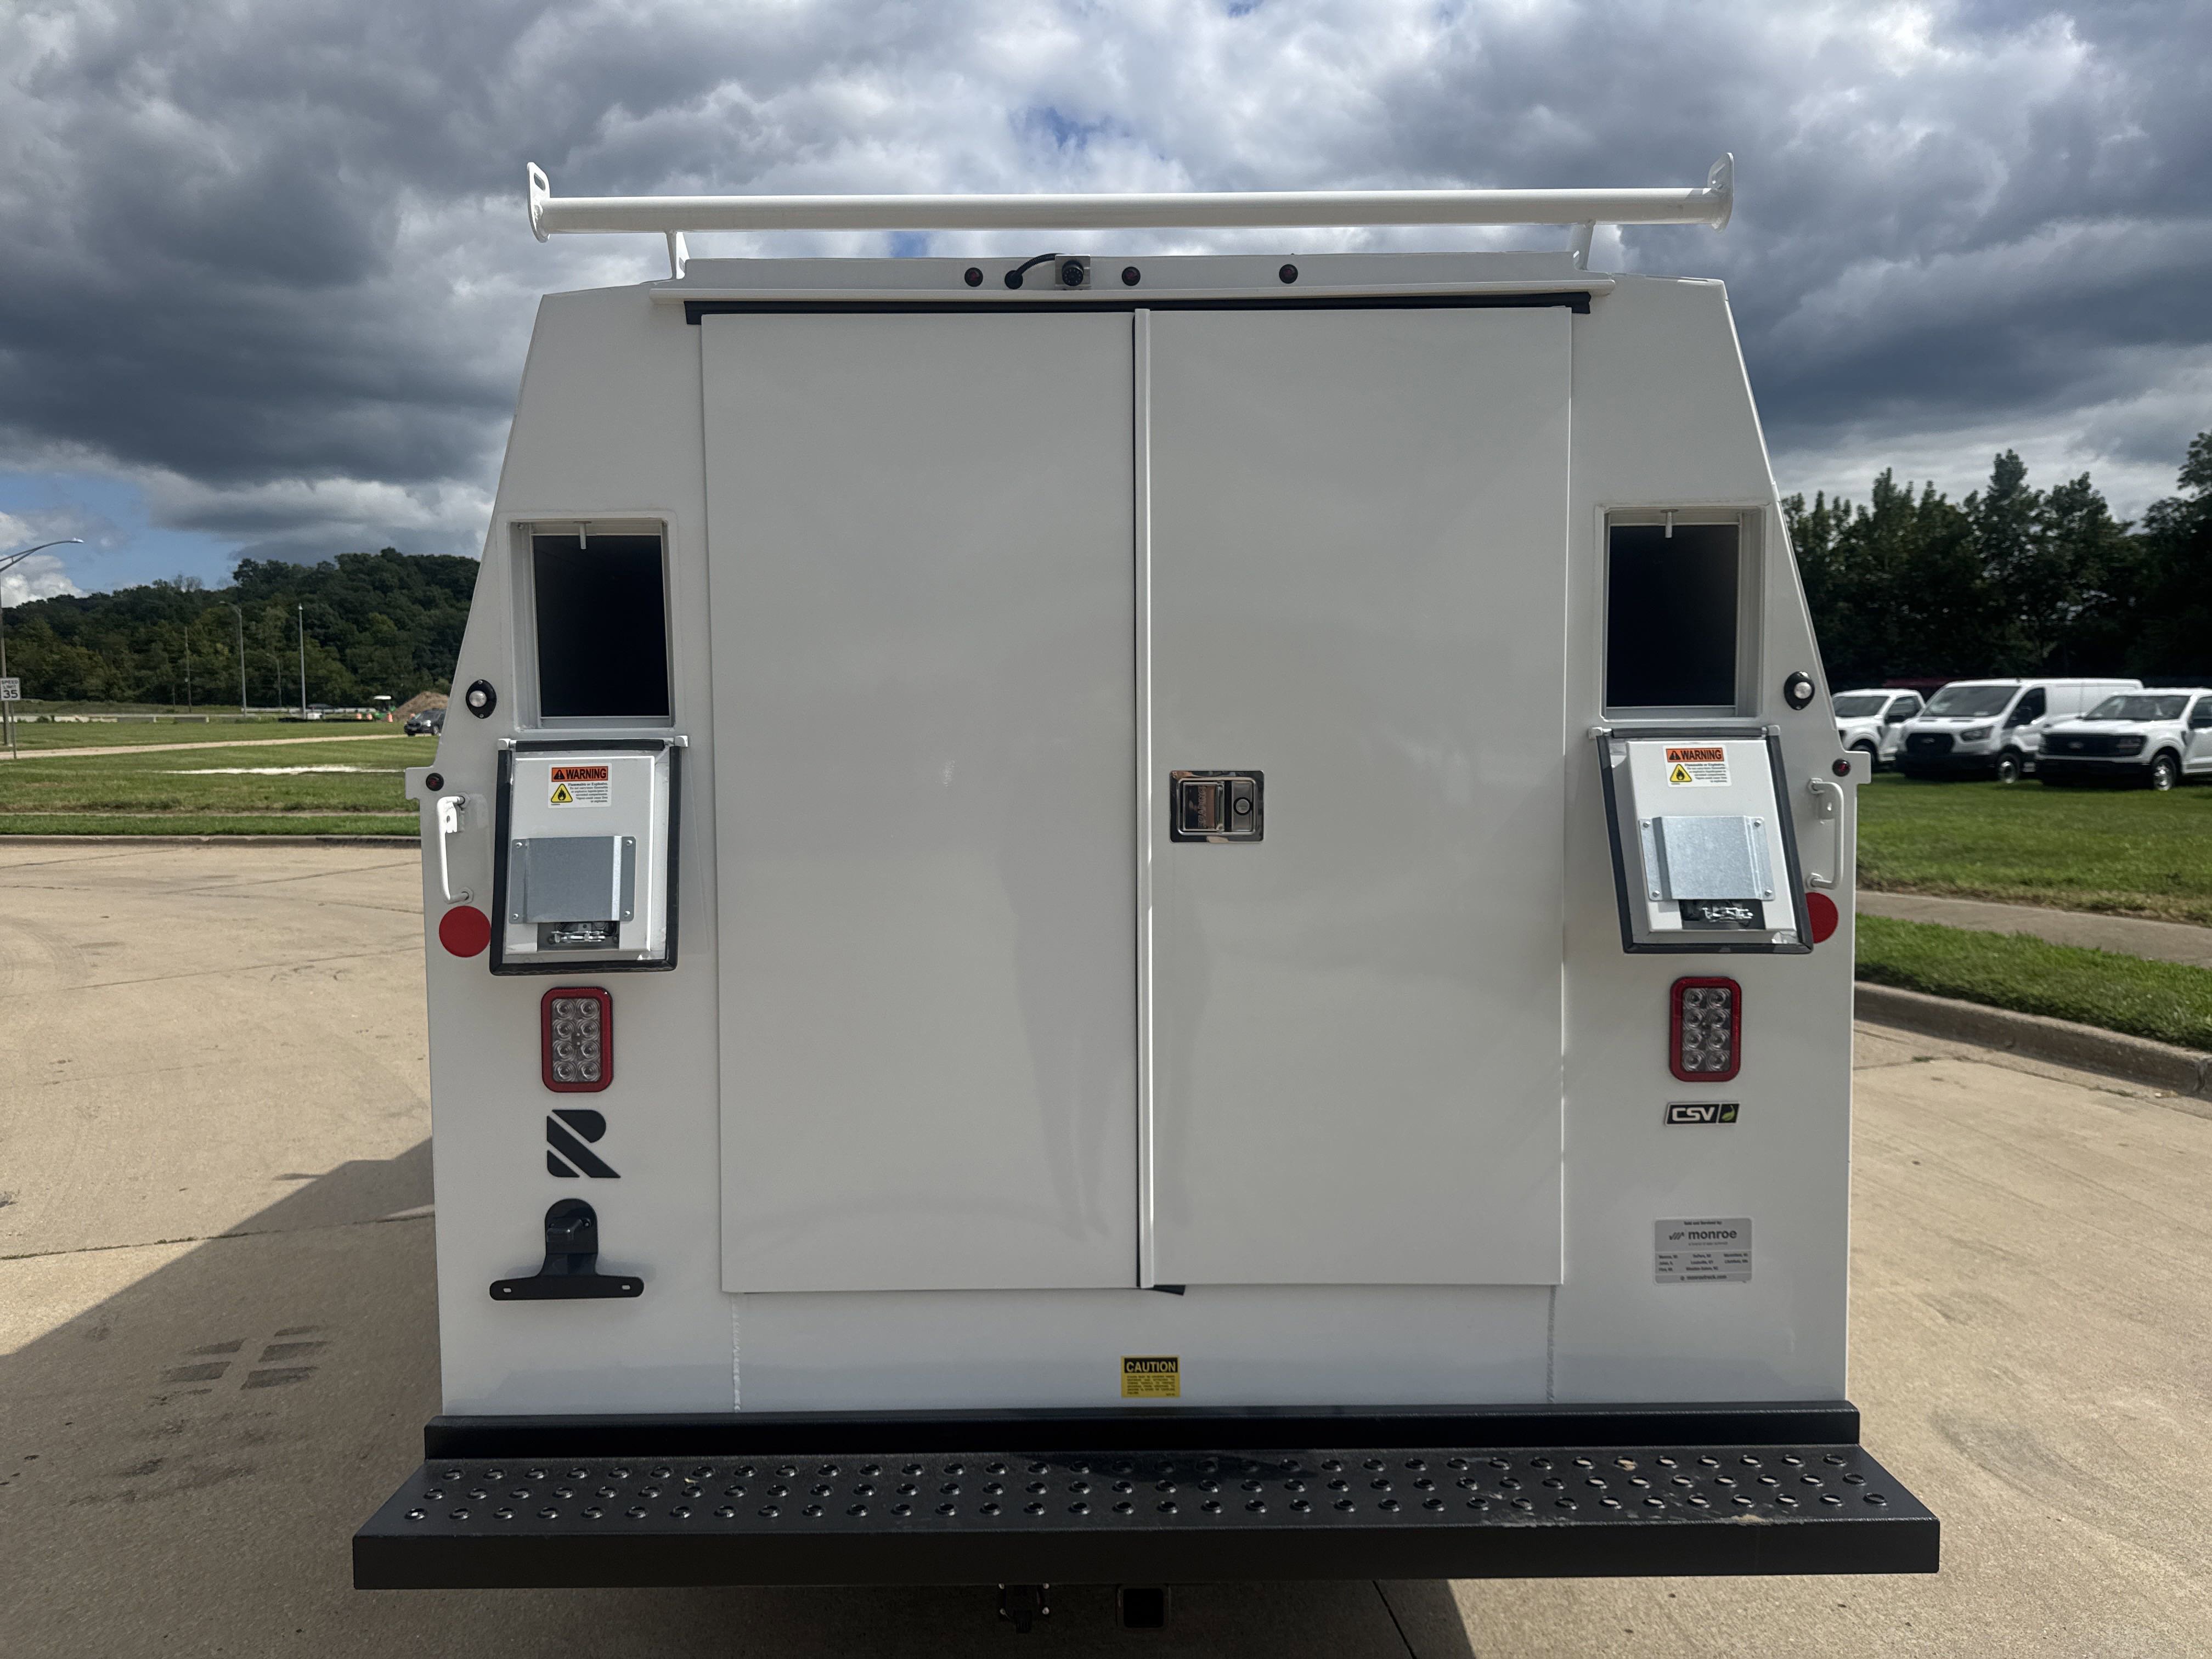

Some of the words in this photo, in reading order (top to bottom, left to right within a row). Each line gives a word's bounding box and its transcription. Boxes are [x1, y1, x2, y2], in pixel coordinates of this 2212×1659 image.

[3, 690, 18, 698] 35
[1680, 749, 1722, 760] WARNING
[566, 768, 607, 780] WARNING
[1672, 1107, 1715, 1121] CSV
[1688, 1230, 1737, 1240] monroe
[1126, 1361, 1176, 1372] CAUTION
